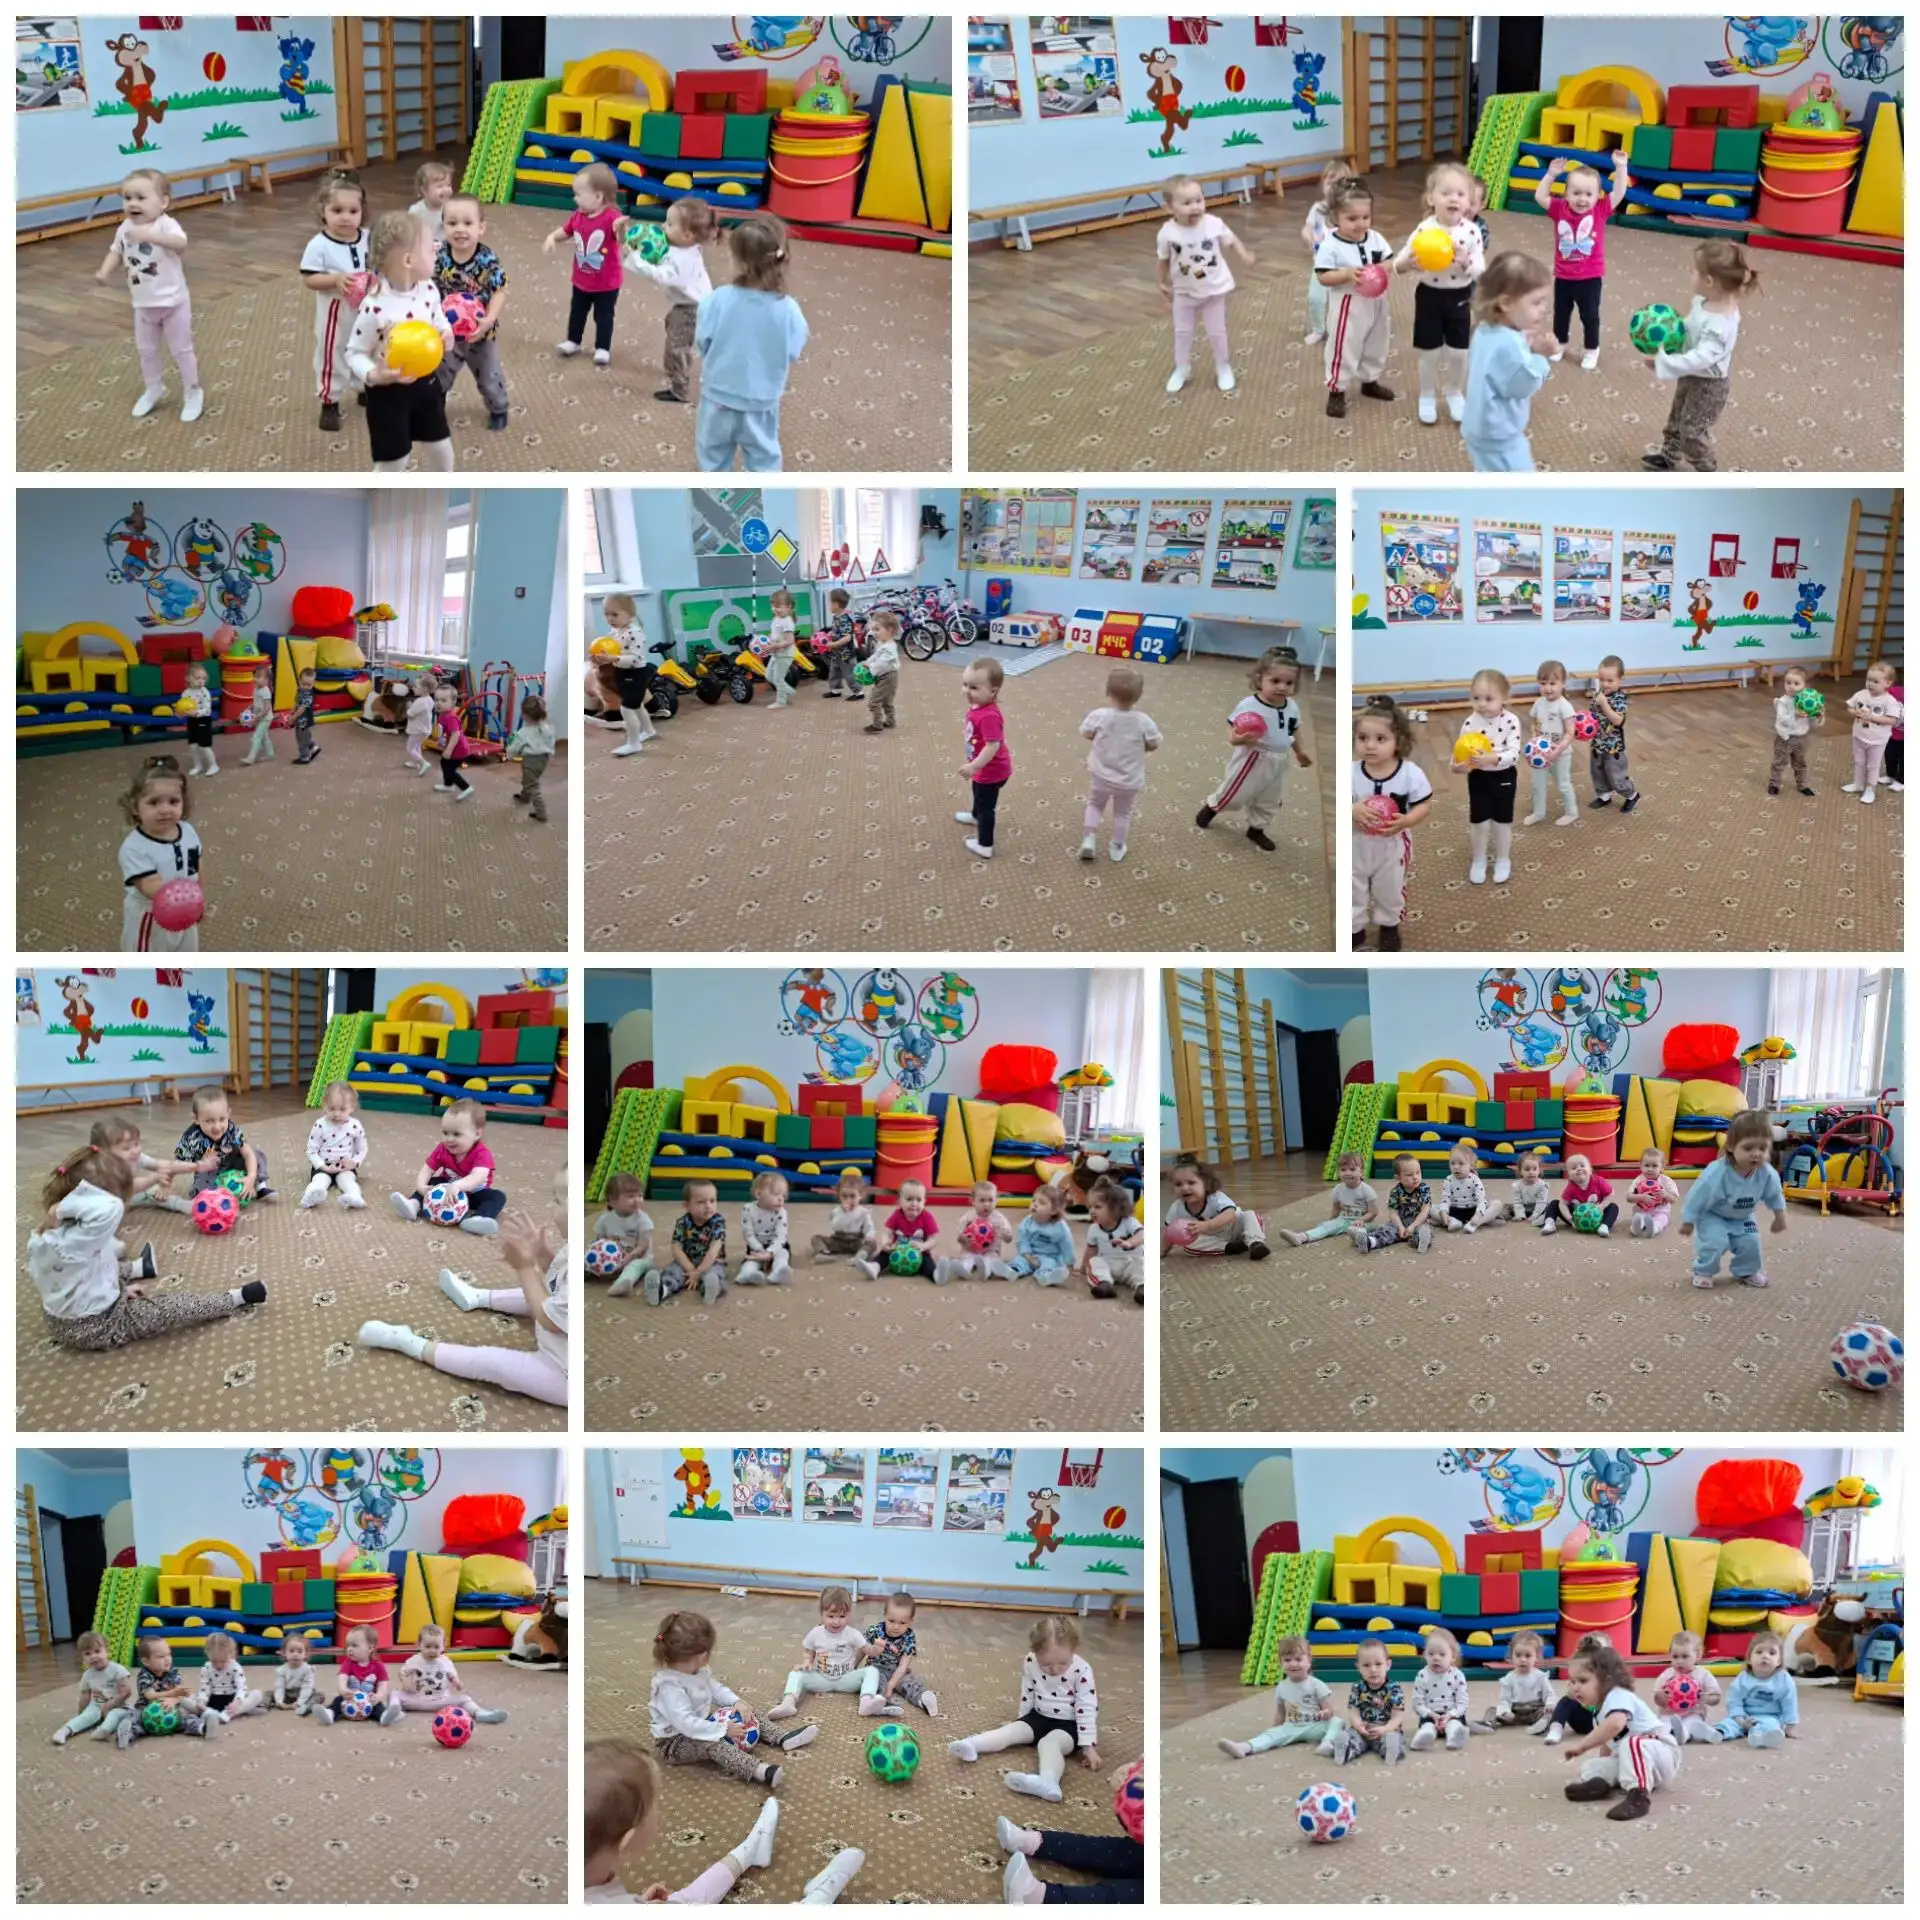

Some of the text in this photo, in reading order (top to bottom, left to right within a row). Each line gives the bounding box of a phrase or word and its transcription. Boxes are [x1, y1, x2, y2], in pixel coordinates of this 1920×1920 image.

[991, 623, 1005, 634] 02
[1071, 627, 1092, 644] 03
[1102, 634, 1127, 649] МЧС
[1140, 637, 1164, 655] 02
